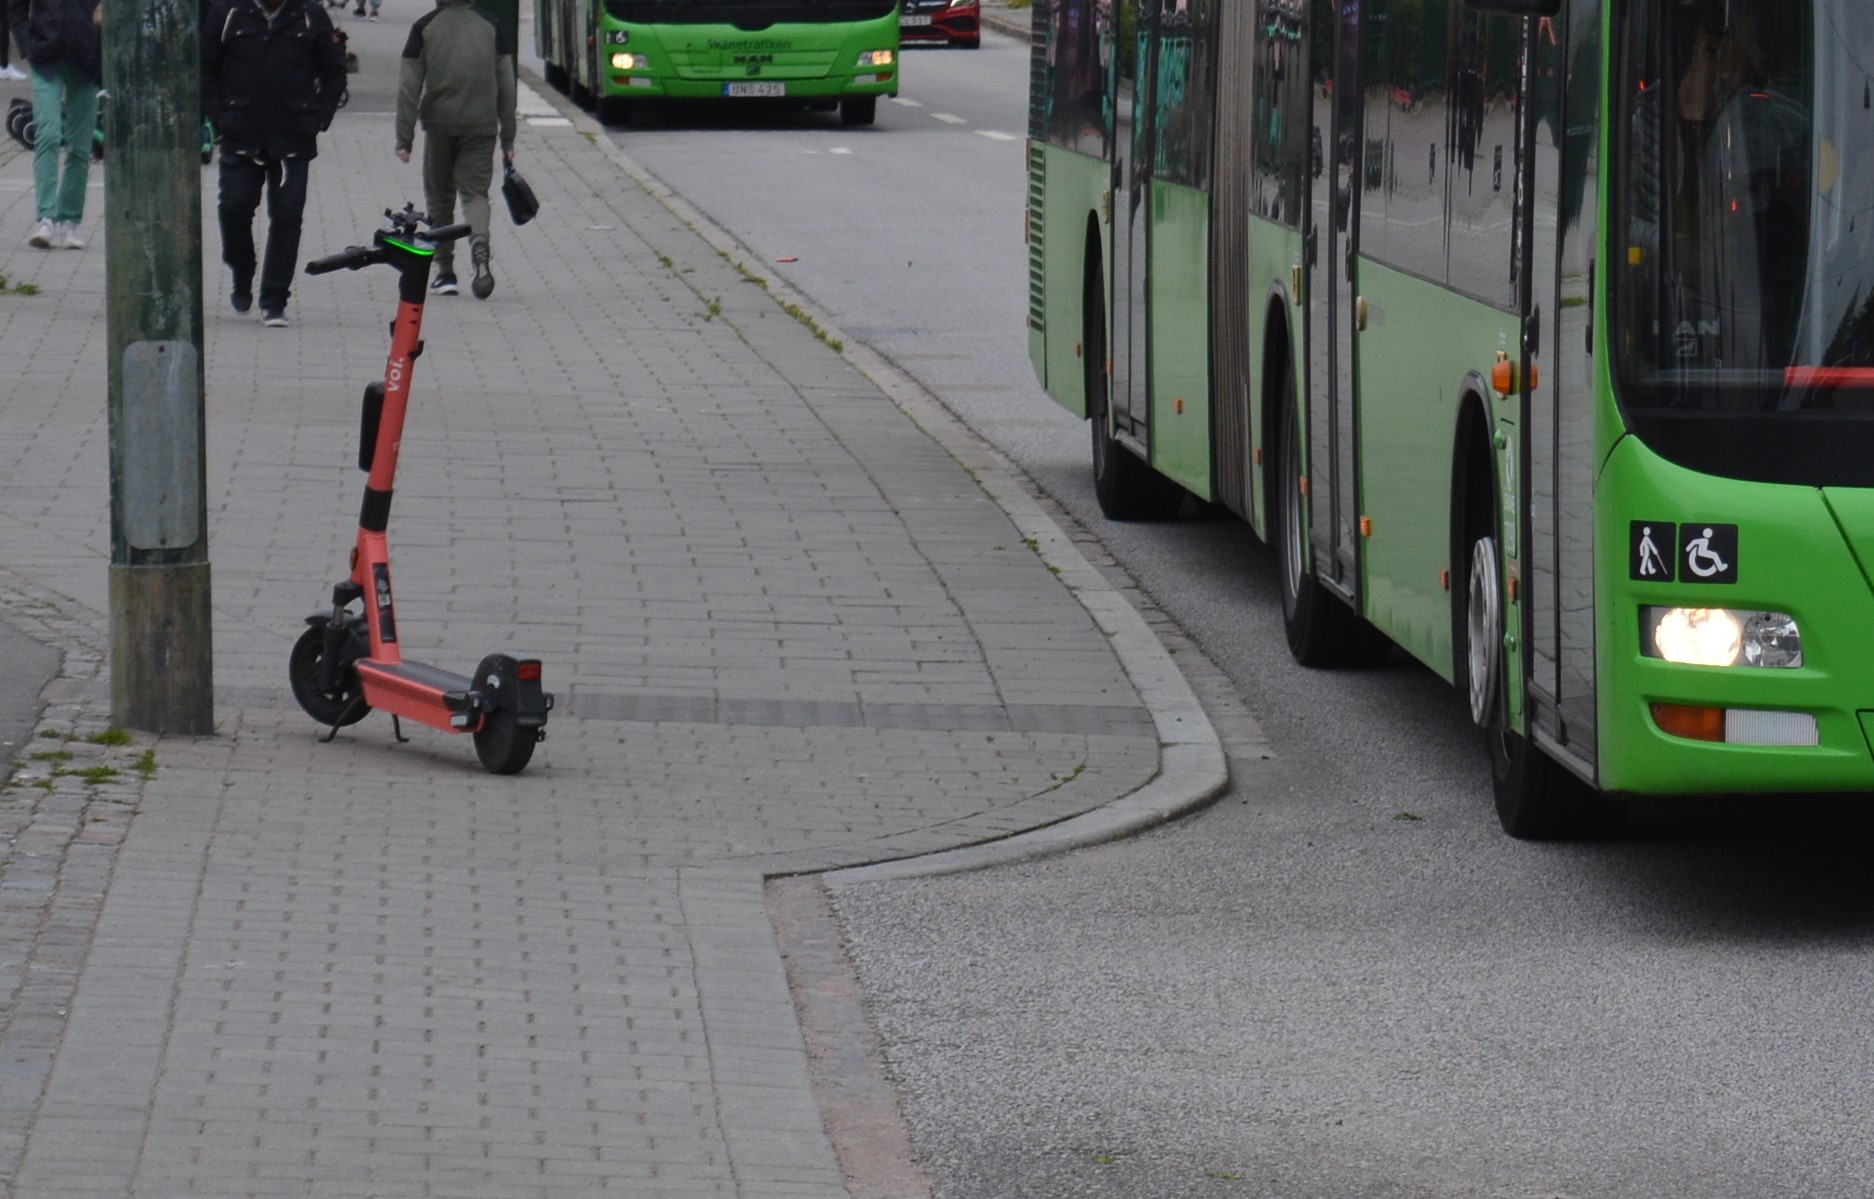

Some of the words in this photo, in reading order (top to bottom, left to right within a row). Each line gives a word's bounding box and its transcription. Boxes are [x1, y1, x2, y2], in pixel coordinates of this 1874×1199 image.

[706, 38, 791, 51] Skånetrafiken
[733, 54, 773, 64] MAN
[759, 84, 780, 94] 425
